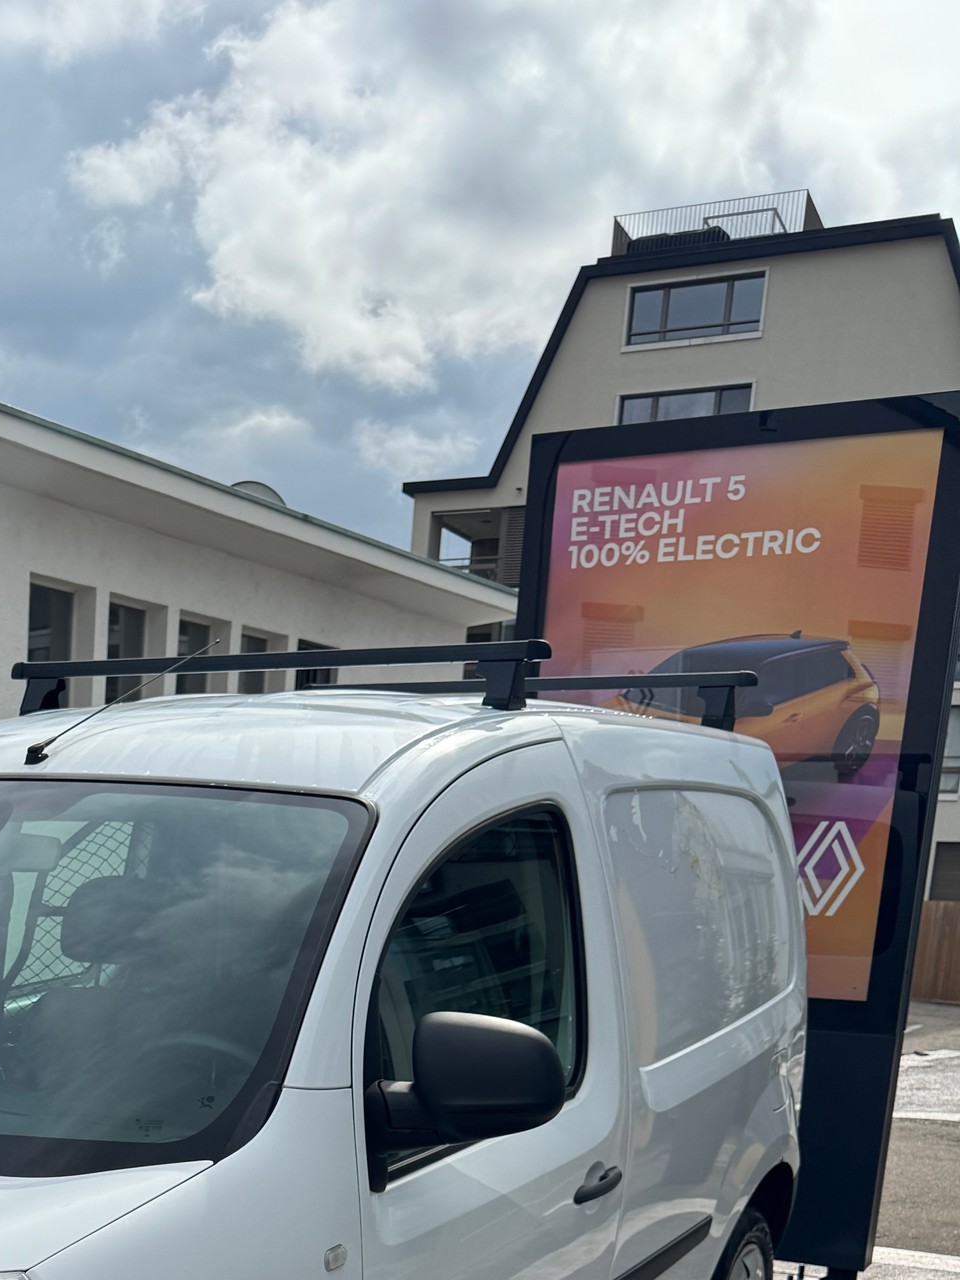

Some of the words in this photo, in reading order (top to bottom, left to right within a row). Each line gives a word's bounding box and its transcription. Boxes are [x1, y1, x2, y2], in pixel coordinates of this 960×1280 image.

[571, 476, 721, 514] RENAULT
[726, 475, 746, 501] 5
[570, 509, 686, 542] E-TECH
[568, 540, 650, 570] 100%
[656, 527, 822, 563] ELECTRIC
